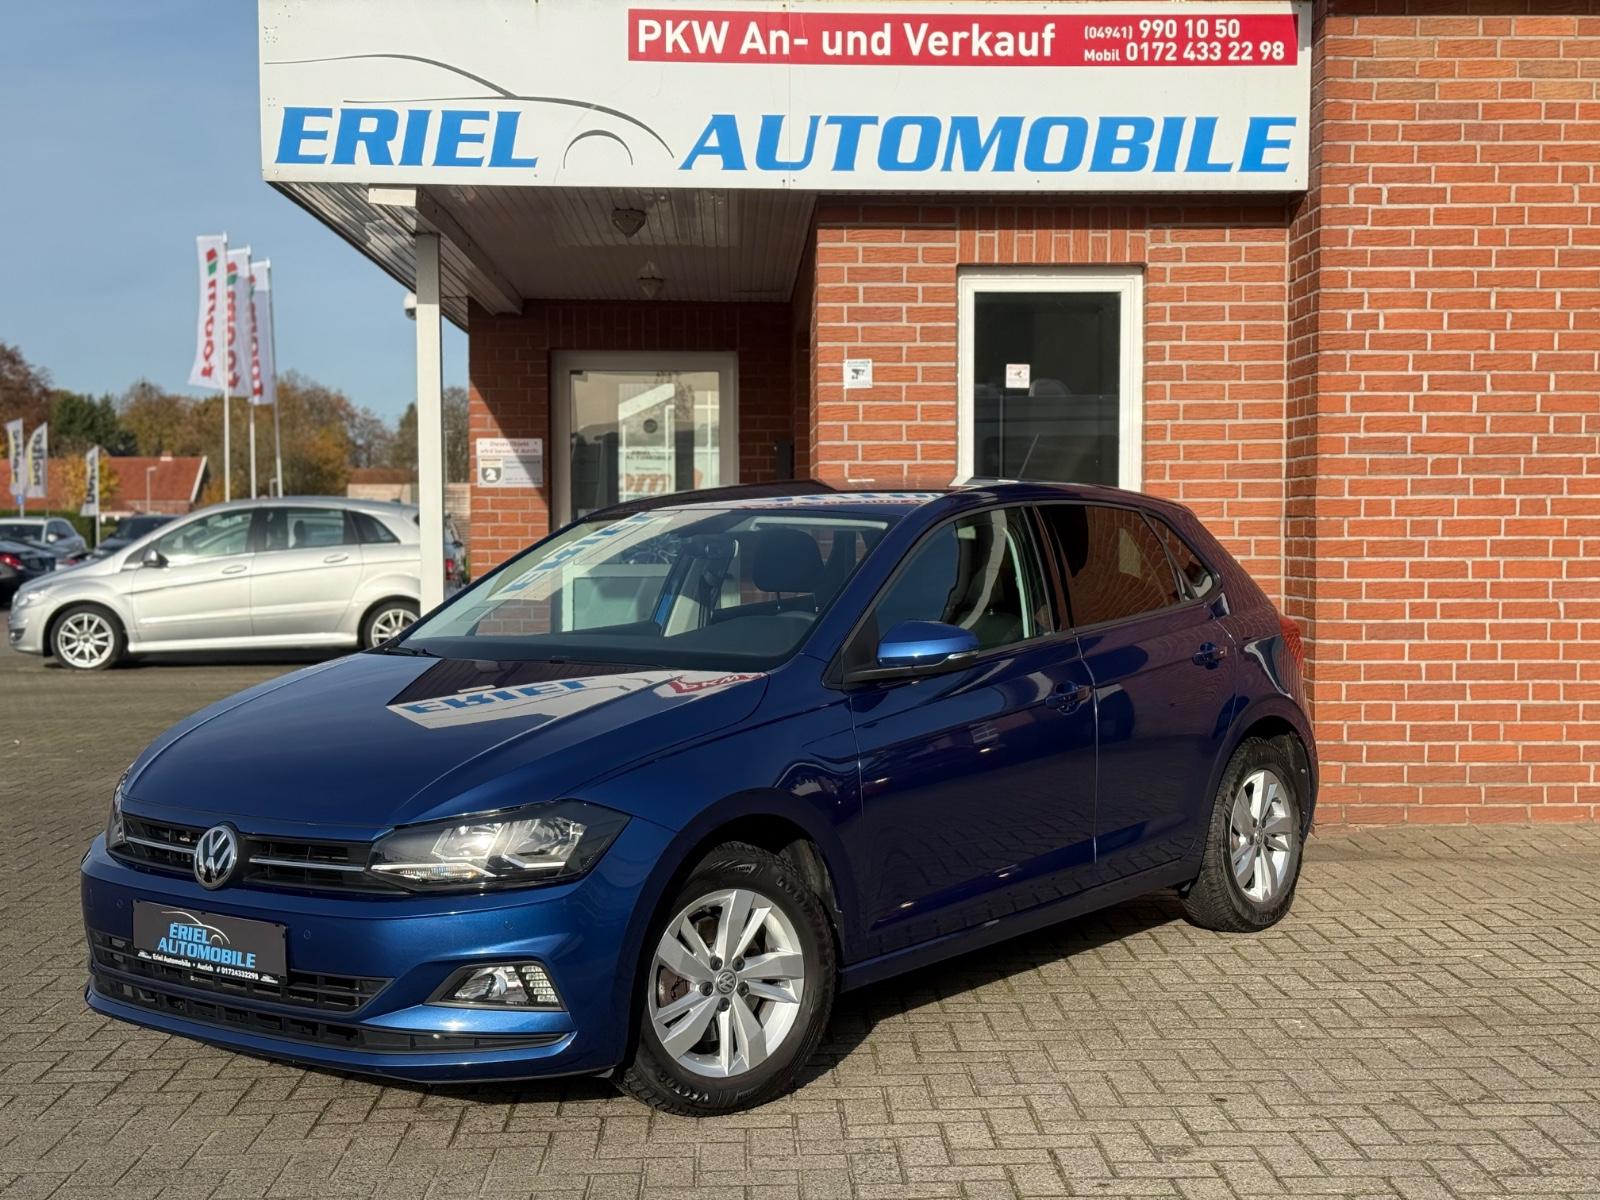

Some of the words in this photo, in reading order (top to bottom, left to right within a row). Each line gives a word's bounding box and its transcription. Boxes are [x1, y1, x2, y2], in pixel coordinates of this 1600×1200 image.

[637, 19, 730, 54] PKW
[739, 20, 809, 55] An-
[822, 22, 892, 57] und
[903, 22, 1056, 57] Verkauf
[1084, 25, 1133, 40] (04941)
[1139, 19, 1177, 39] 990
[1184, 19, 1209, 39] 10
[1215, 18, 1240, 38] 50
[1084, 48, 1121, 62] Mobil
[1126, 41, 1177, 62] 0172
[1182, 41, 1222, 61] 433
[1228, 41, 1253, 61] 22
[1259, 40, 1285, 61] 98
[273, 106, 539, 168] ERIEL
[678, 113, 1298, 173] AUTOMOBILE
[168, 922, 210, 945] ERIEL
[157, 937, 257, 969] AUTOMOBILE
[163, 955, 191, 968] Automobile
[197, 963, 214, 972] Aurich
